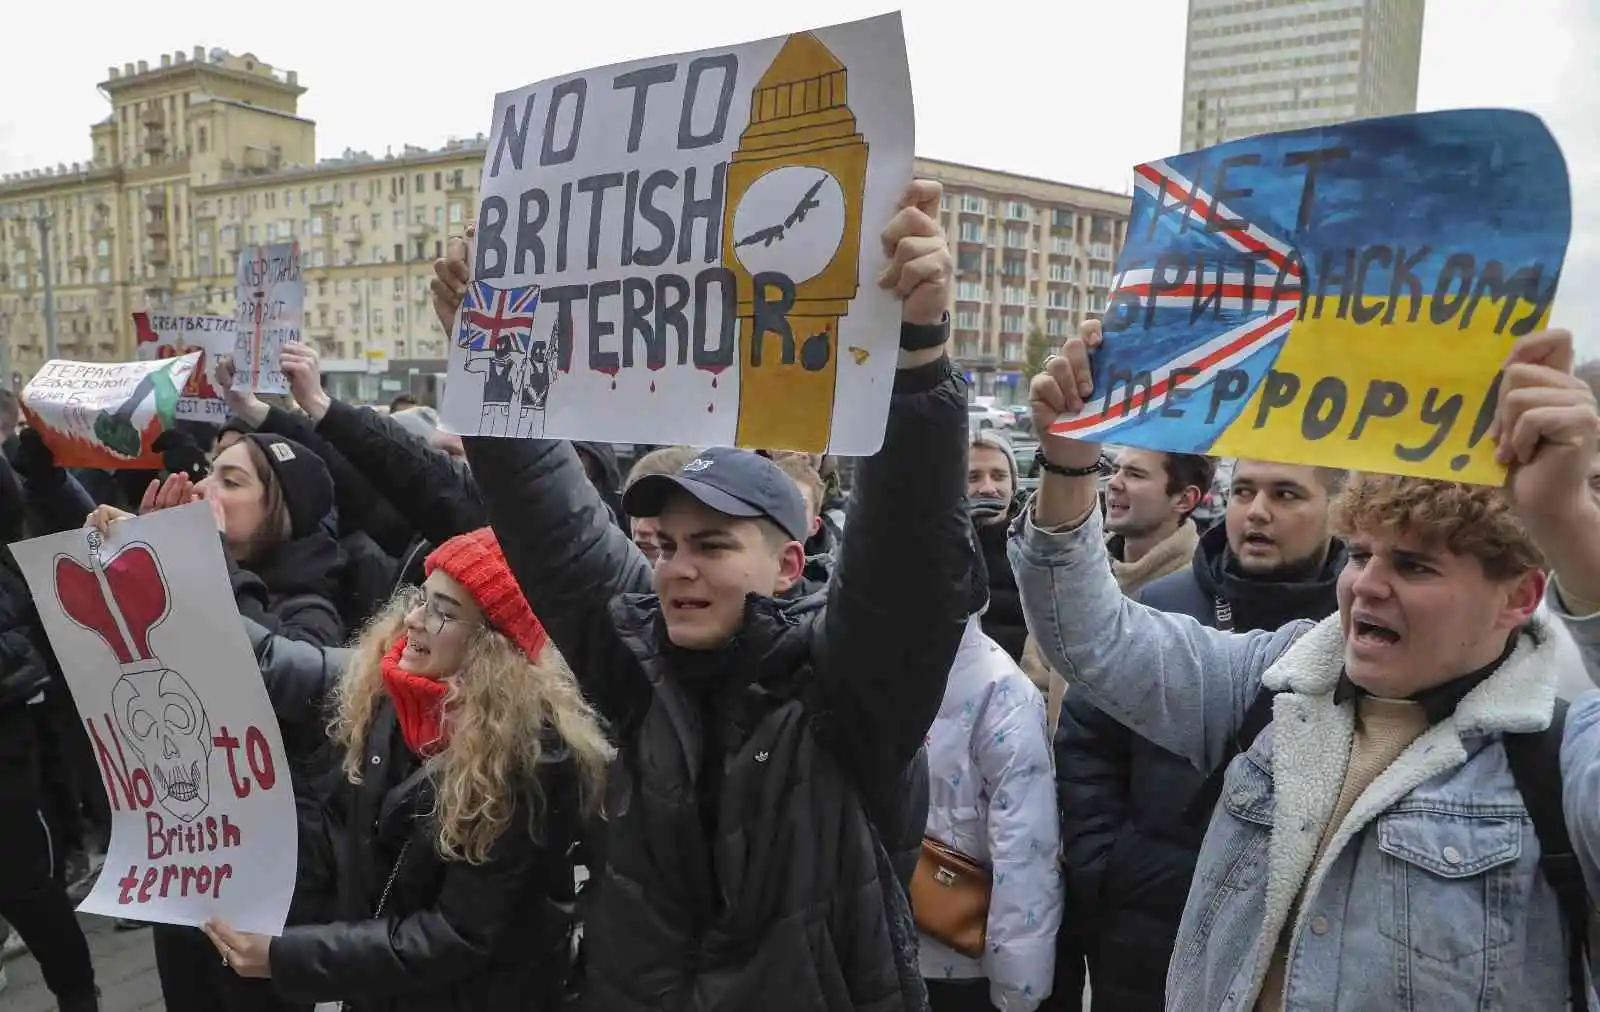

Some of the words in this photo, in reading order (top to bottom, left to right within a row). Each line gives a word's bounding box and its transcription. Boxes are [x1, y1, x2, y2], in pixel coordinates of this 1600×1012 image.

[490, 77, 587, 178] NO
[612, 53, 739, 154] TO
[475, 160, 727, 282] BRITISH
[1146, 144, 1354, 244] НЕТ
[1102, 243, 1559, 337] БРИТАНСКОМУ
[86, 712, 155, 812] No
[212, 726, 275, 799] to
[118, 864, 233, 905] terror
[146, 811, 241, 860] British
